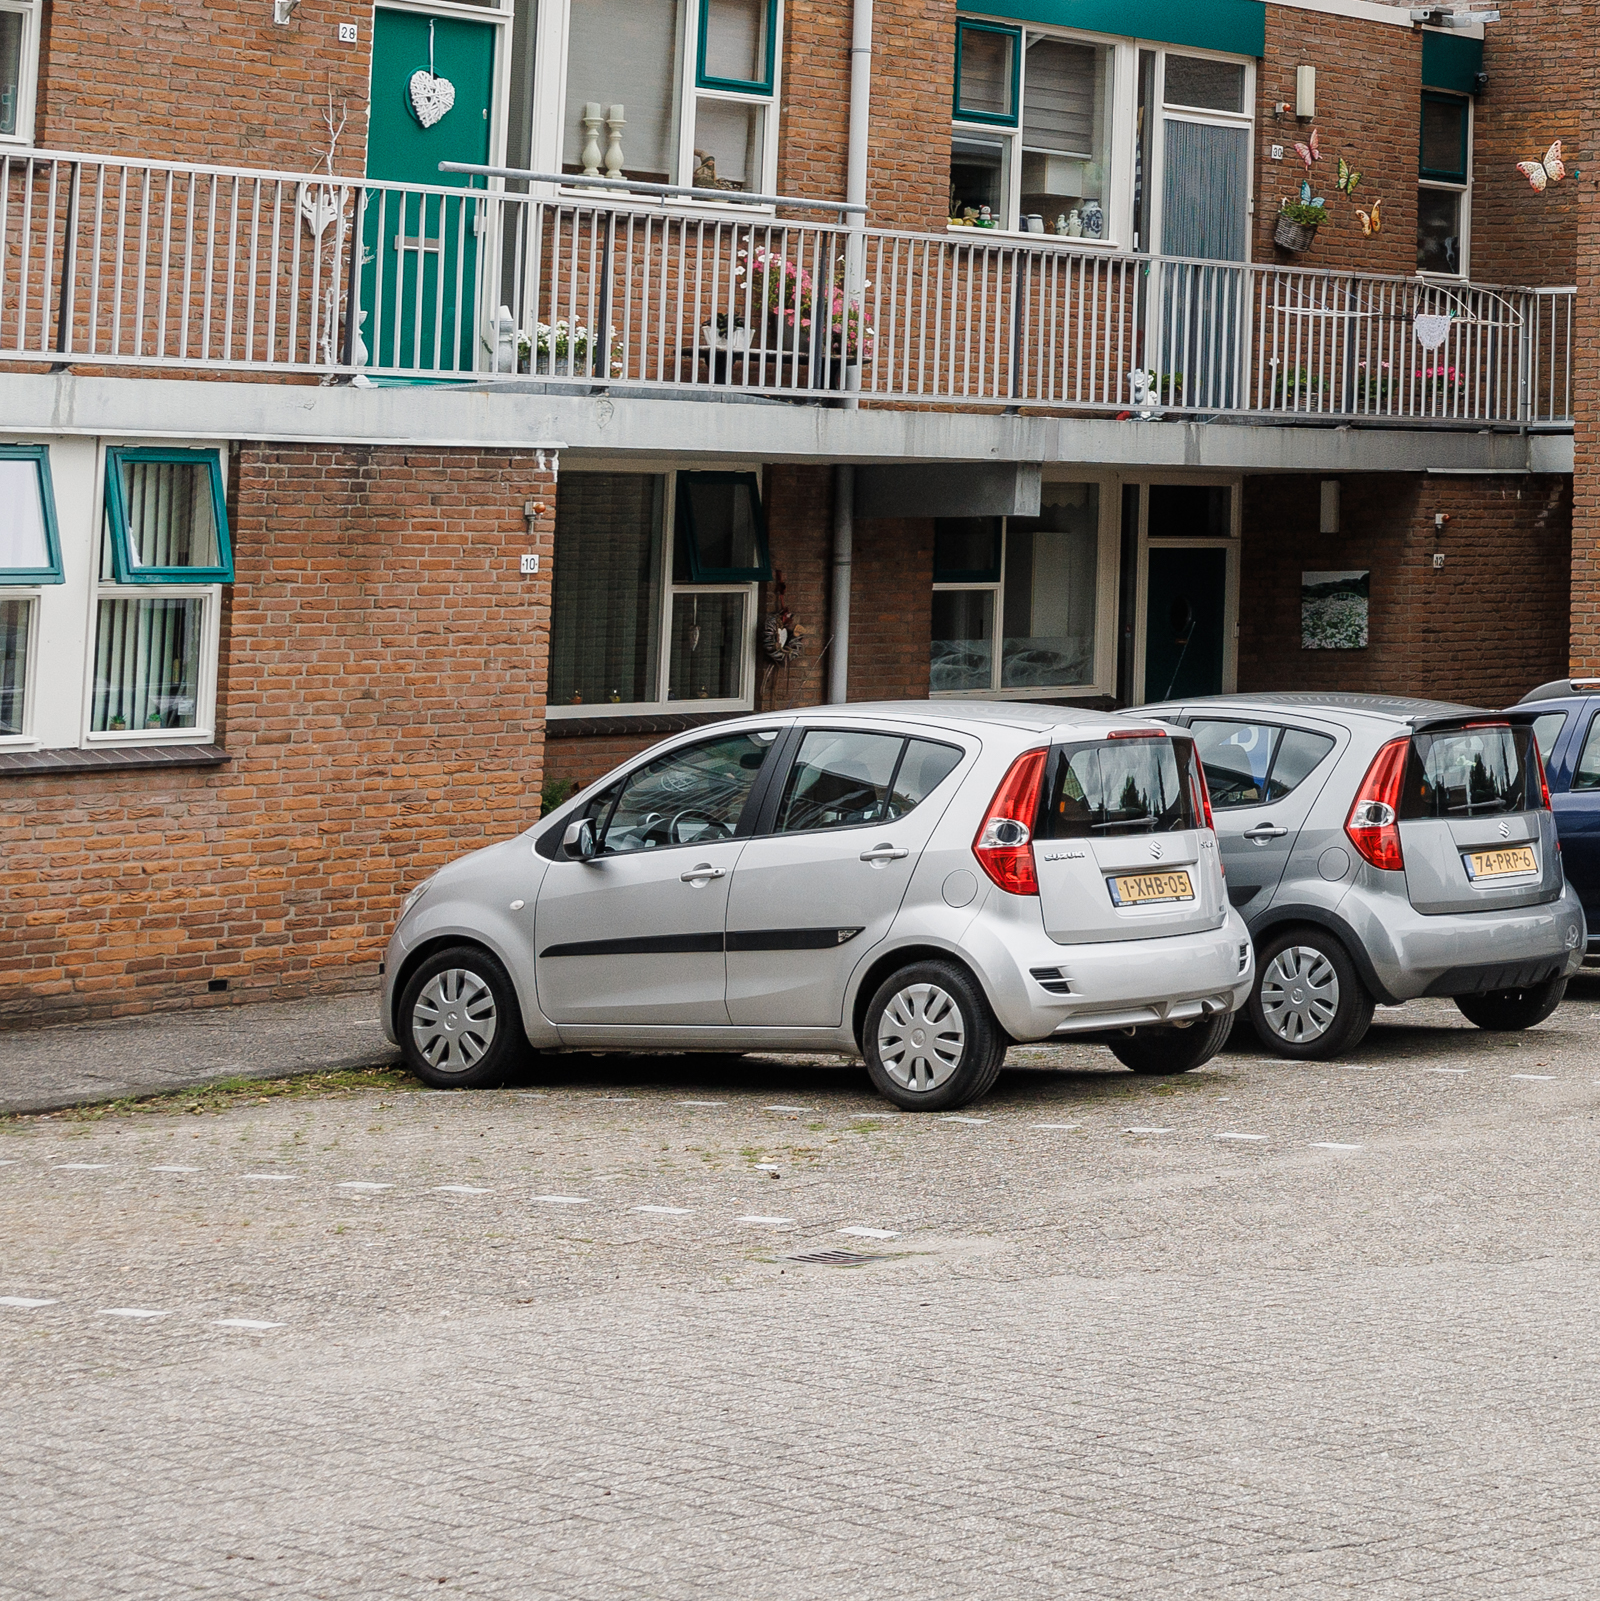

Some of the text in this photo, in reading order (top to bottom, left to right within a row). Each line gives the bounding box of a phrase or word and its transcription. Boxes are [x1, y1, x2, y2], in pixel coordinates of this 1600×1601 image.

[341, 26, 355, 40] 28
[1273, 147, 1282, 158] 30
[525, 558, 536, 570] 10
[1475, 851, 1531, 873] 74-PRP-6
[1123, 875, 1188, 898] 1-XHB-05
